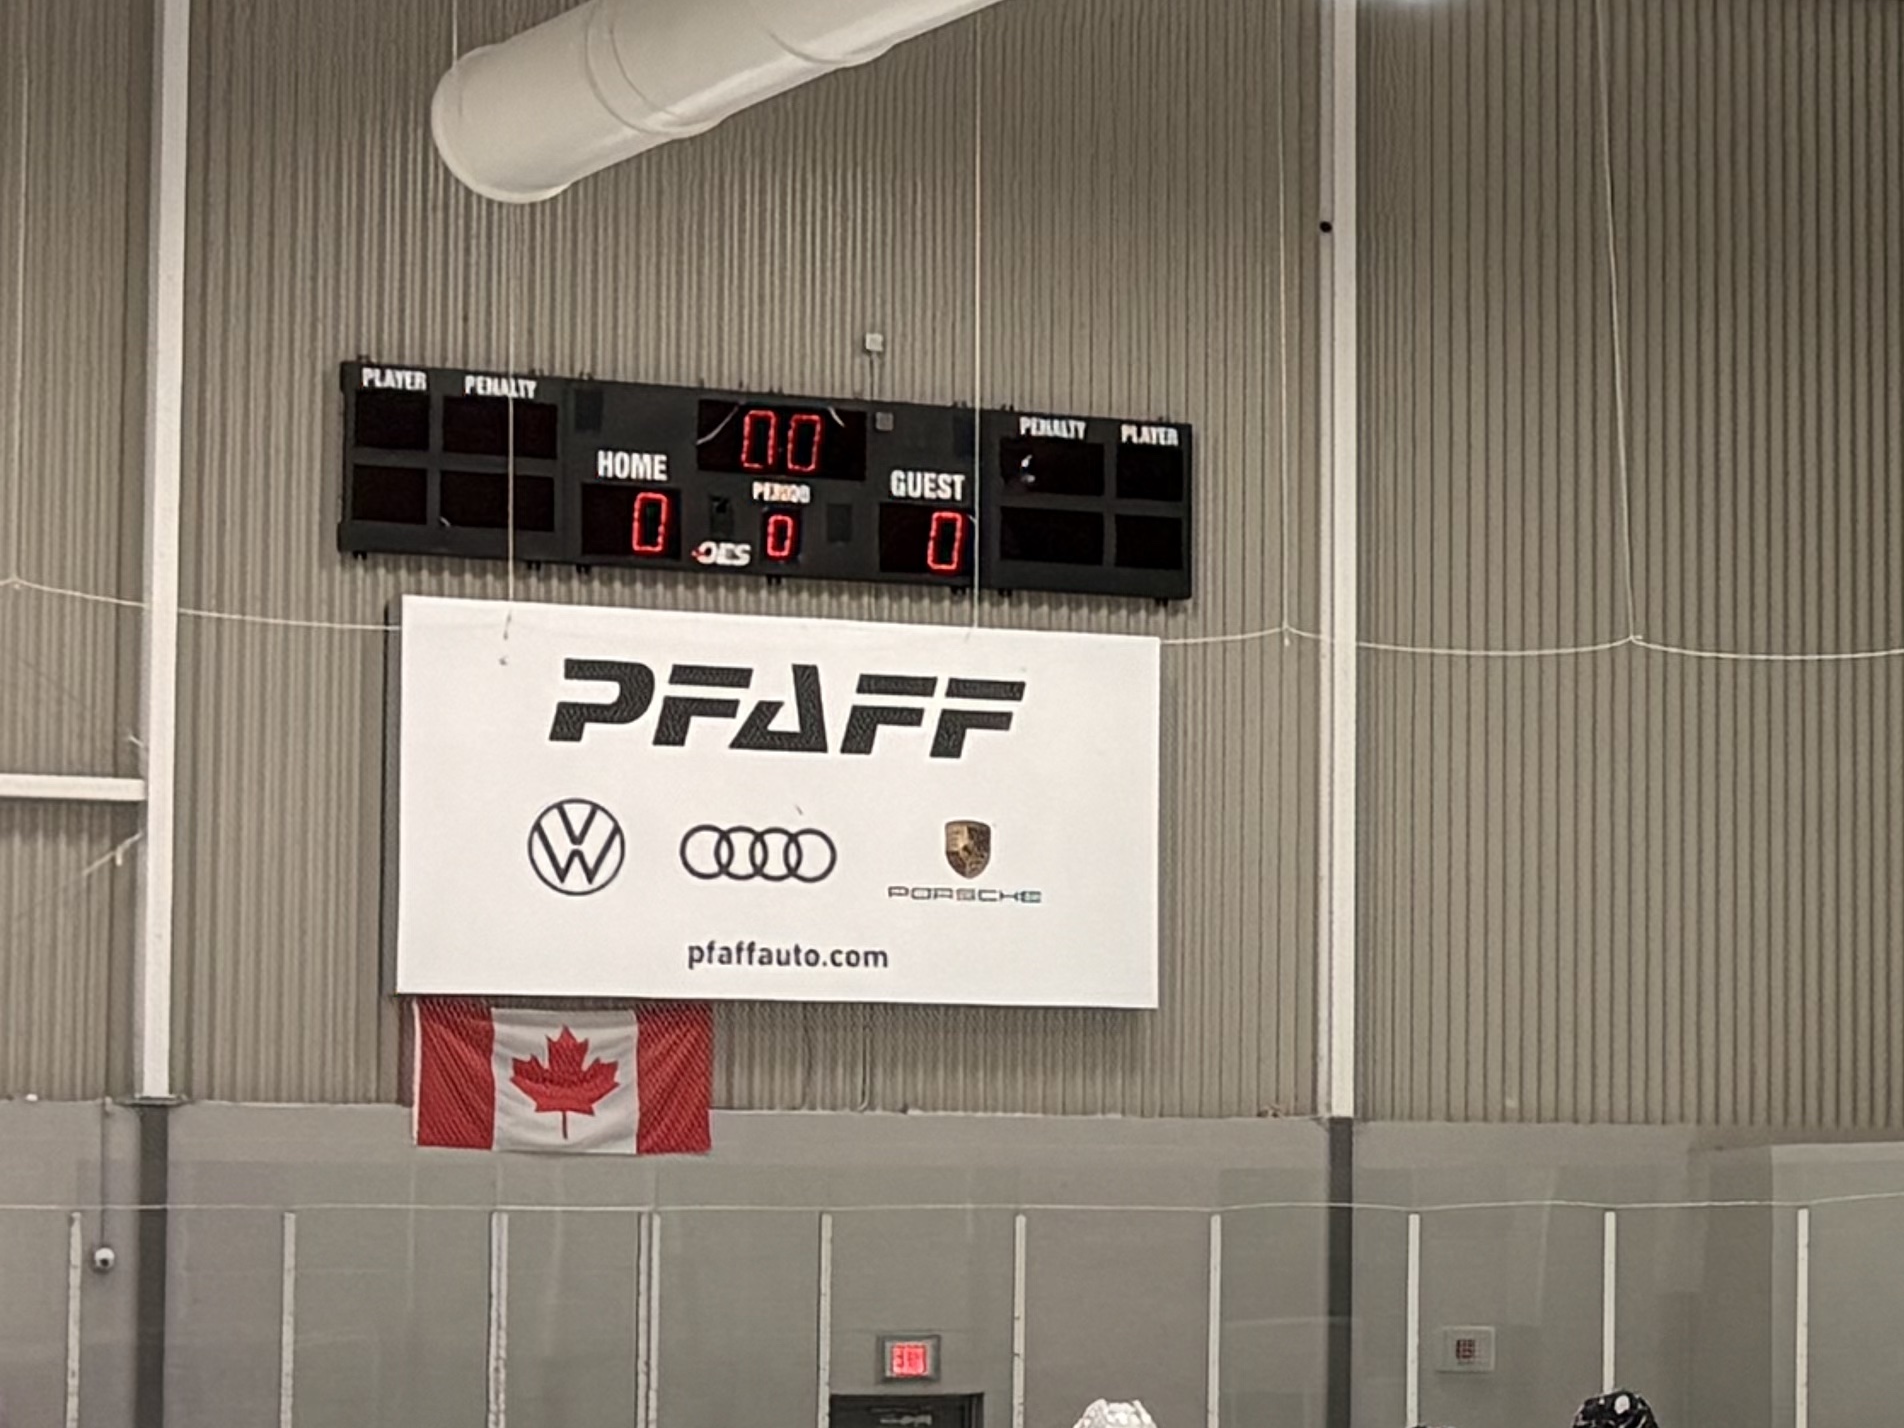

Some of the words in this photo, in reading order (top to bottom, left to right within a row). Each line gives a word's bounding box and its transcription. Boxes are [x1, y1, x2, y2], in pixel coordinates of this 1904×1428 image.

[362, 368, 427, 391] PLAYER
[464, 375, 537, 399] PENALTY
[1019, 417, 1086, 439] PENALTY
[1121, 425, 1179, 446] PLAYER
[597, 450, 667, 481] HOME
[753, 482, 810, 504] PERIOD
[890, 470, 965, 501] GUEST
[632, 492, 667, 552] 0
[767, 514, 793, 556] 0
[927, 512, 962, 570] 0
[549, 658, 1026, 759] PFAFF
[888, 886, 1042, 904] PORSCHE
[688, 940, 888, 970] pfaffauto.com
